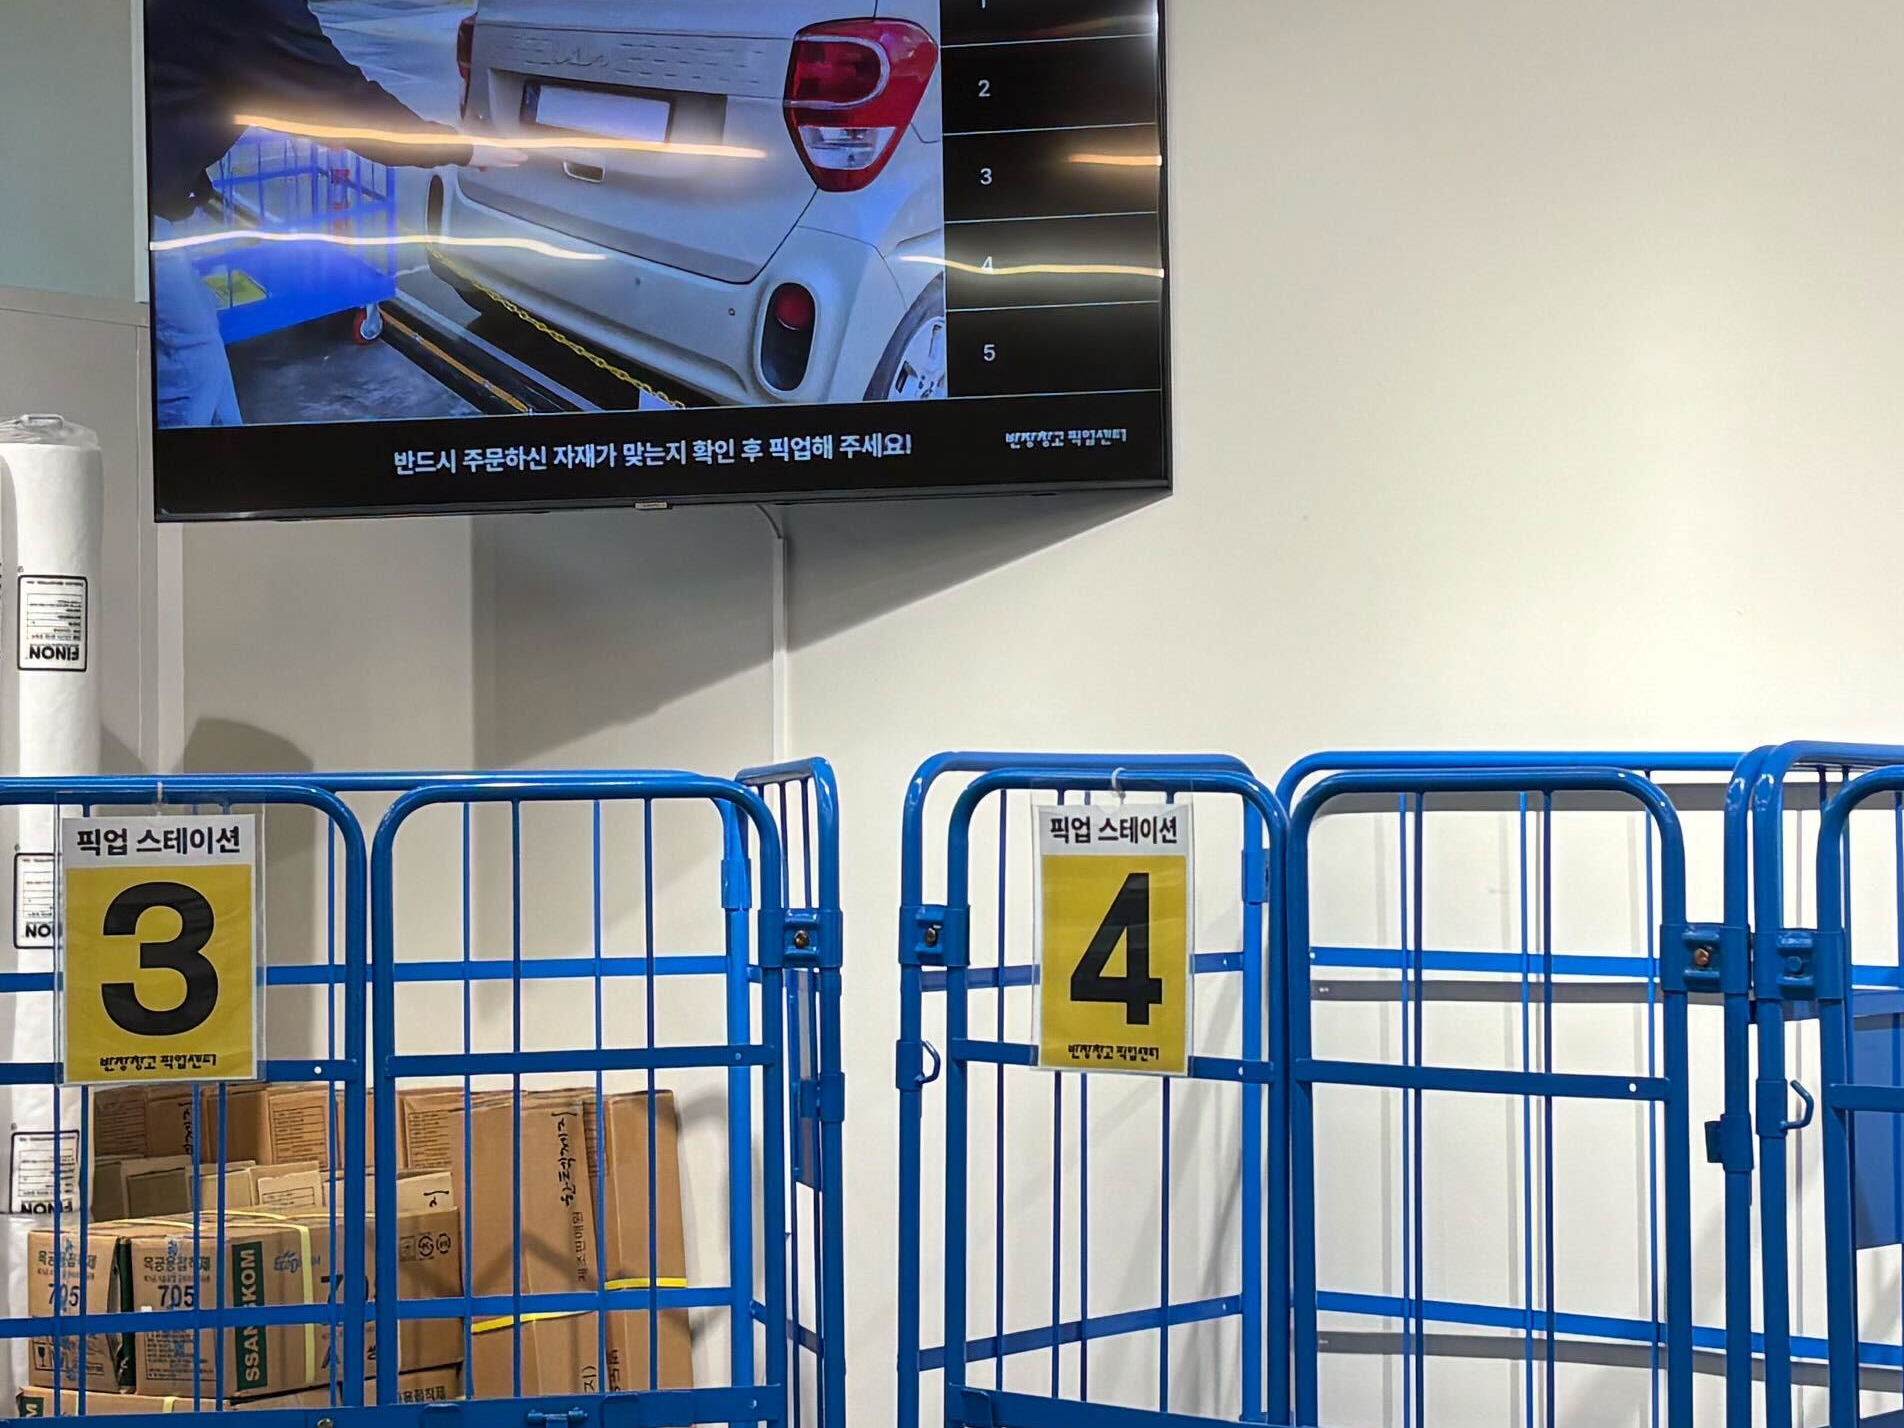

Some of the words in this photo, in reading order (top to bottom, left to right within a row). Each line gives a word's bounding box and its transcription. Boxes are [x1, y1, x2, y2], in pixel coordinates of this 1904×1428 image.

[977, 79, 991, 99] 2
[979, 167, 993, 187] 3
[981, 255, 995, 273] 4
[983, 344, 996, 361] 5
[393, 448, 457, 476] 반드시
[462, 445, 547, 474] 주문하신
[553, 443, 617, 471] 자재가
[623, 440, 687, 468] 맞는지
[692, 438, 735, 466] 확인
[740, 438, 765, 463] 후
[768, 435, 833, 461] 픽업해
[839, 433, 912, 459] 주세요!
[29, 645, 80, 660] FINON
[1050, 816, 1091, 844] 픽업
[1097, 815, 1178, 844] 스테이션
[76, 827, 127, 856] 픽업
[136, 826, 241, 855] 스테이션
[101, 882, 218, 1036] 3
[1070, 872, 1163, 1025] 4
[21, 1201, 73, 1214] FNON
[158, 1285, 195, 1307] 705
[240, 1249, 260, 1382] SSANKOM
